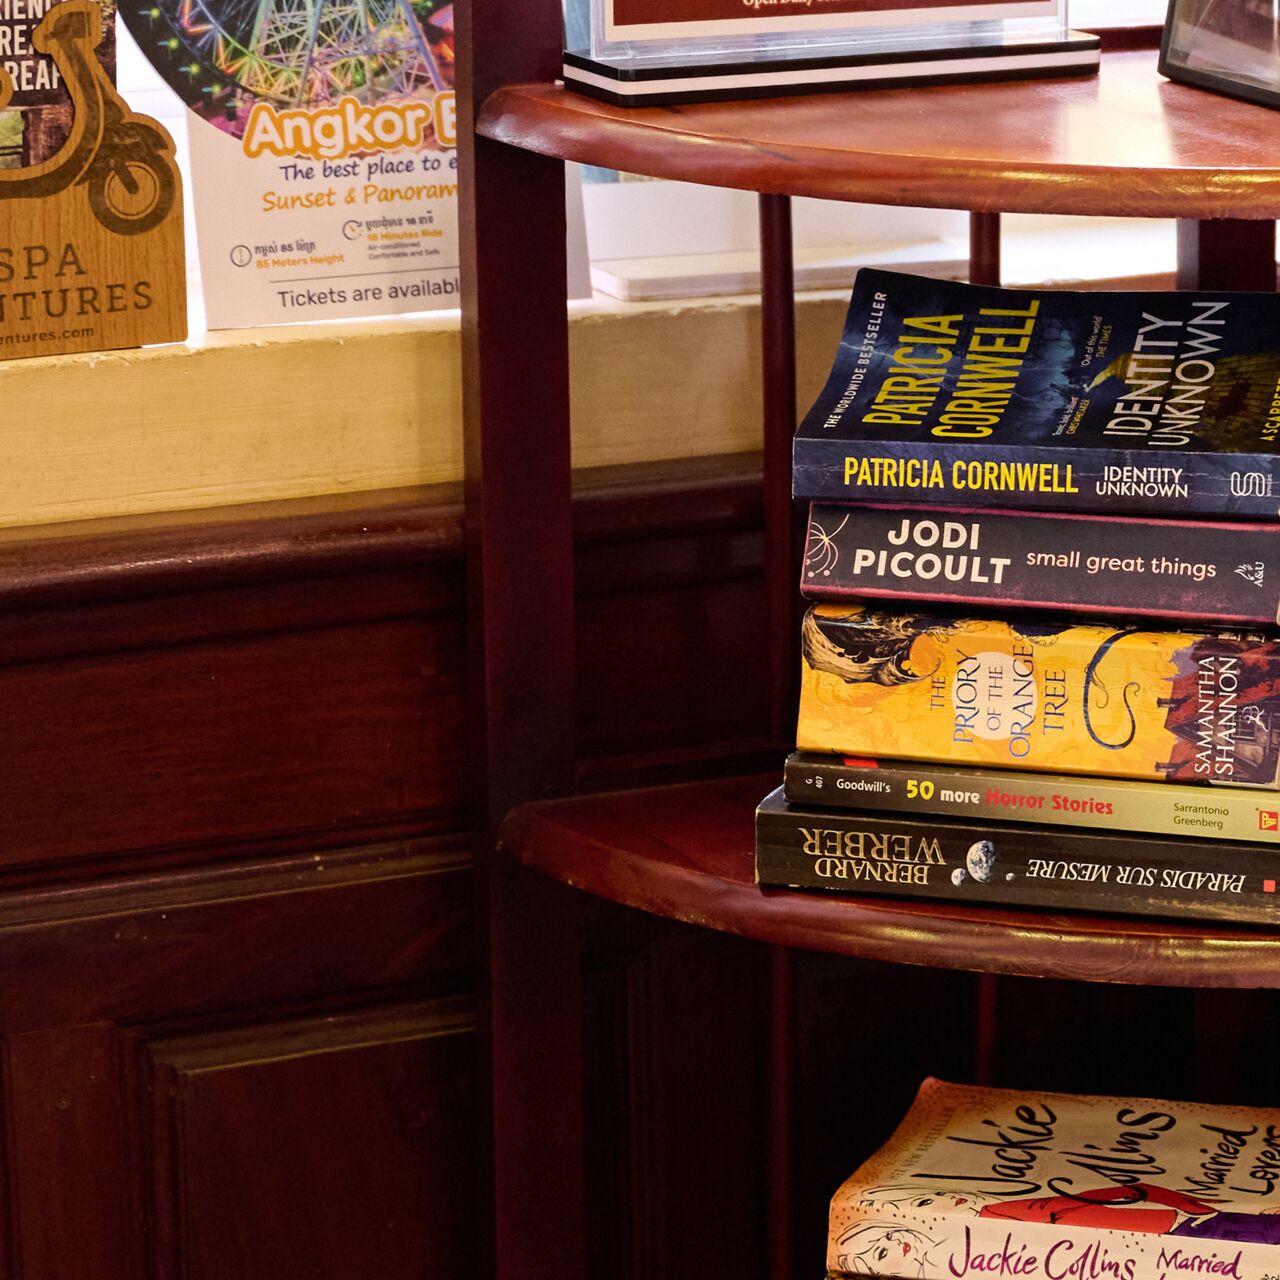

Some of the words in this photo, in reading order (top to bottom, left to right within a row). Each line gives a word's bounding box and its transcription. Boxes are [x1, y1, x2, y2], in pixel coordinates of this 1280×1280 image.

[245, 98, 430, 158] Angkor
[280, 163, 316, 181] The
[323, 160, 360, 178] best
[367, 156, 415, 181] place
[422, 155, 442, 172] to
[262, 188, 336, 212] Sunset
[344, 187, 357, 205] &
[277, 287, 348, 308] Tickets
[352, 285, 383, 302] are
[824, 410, 840, 429] THE
[834, 366, 868, 416] WORLDWIDE
[859, 290, 889, 366] BESTSELLER
[861, 312, 965, 426] PATRICIA
[930, 299, 1041, 439] CORNWELL
[1102, 310, 1185, 436] IDENTITY
[1147, 300, 1232, 446] UNKNOWN
[843, 455, 945, 488] PATRICIA
[951, 460, 1080, 493] CORNWELL
[1095, 480, 1189, 498] UNKNOWN
[1102, 465, 1184, 482] IDENTITY
[886, 518, 981, 550] JODI
[852, 548, 1012, 585] PICOULT
[1026, 550, 1081, 568] small
[1086, 552, 1146, 578] great
[1150, 556, 1218, 582] things
[928, 674, 947, 710] THE
[953, 648, 982, 744] PRIORY
[987, 664, 1004, 697] THE
[987, 701, 1003, 733] OF
[1009, 644, 1035, 759] ORANGE
[1043, 667, 1067, 736] TREE
[1194, 655, 1215, 775] SAMANTHA
[1215, 655, 1239, 776] SHANNON
[836, 778, 892, 795] Goodwill's
[906, 778, 936, 801] 50
[940, 787, 980, 806] more
[985, 788, 1047, 812] Horror
[1051, 793, 1114, 816] Stories
[1174, 801, 1230, 817] Sarrantonio
[1174, 814, 1224, 831] Greenberg
[798, 826, 949, 866] WERBER
[815, 856, 930, 885] BERNARD
[1026, 858, 1110, 884] MESURE
[1116, 866, 1152, 887] SUR
[1155, 870, 1248, 894] PARADIS
[948, 1225, 1038, 1278] Jackie
[1157, 1246, 1243, 1280] Married
